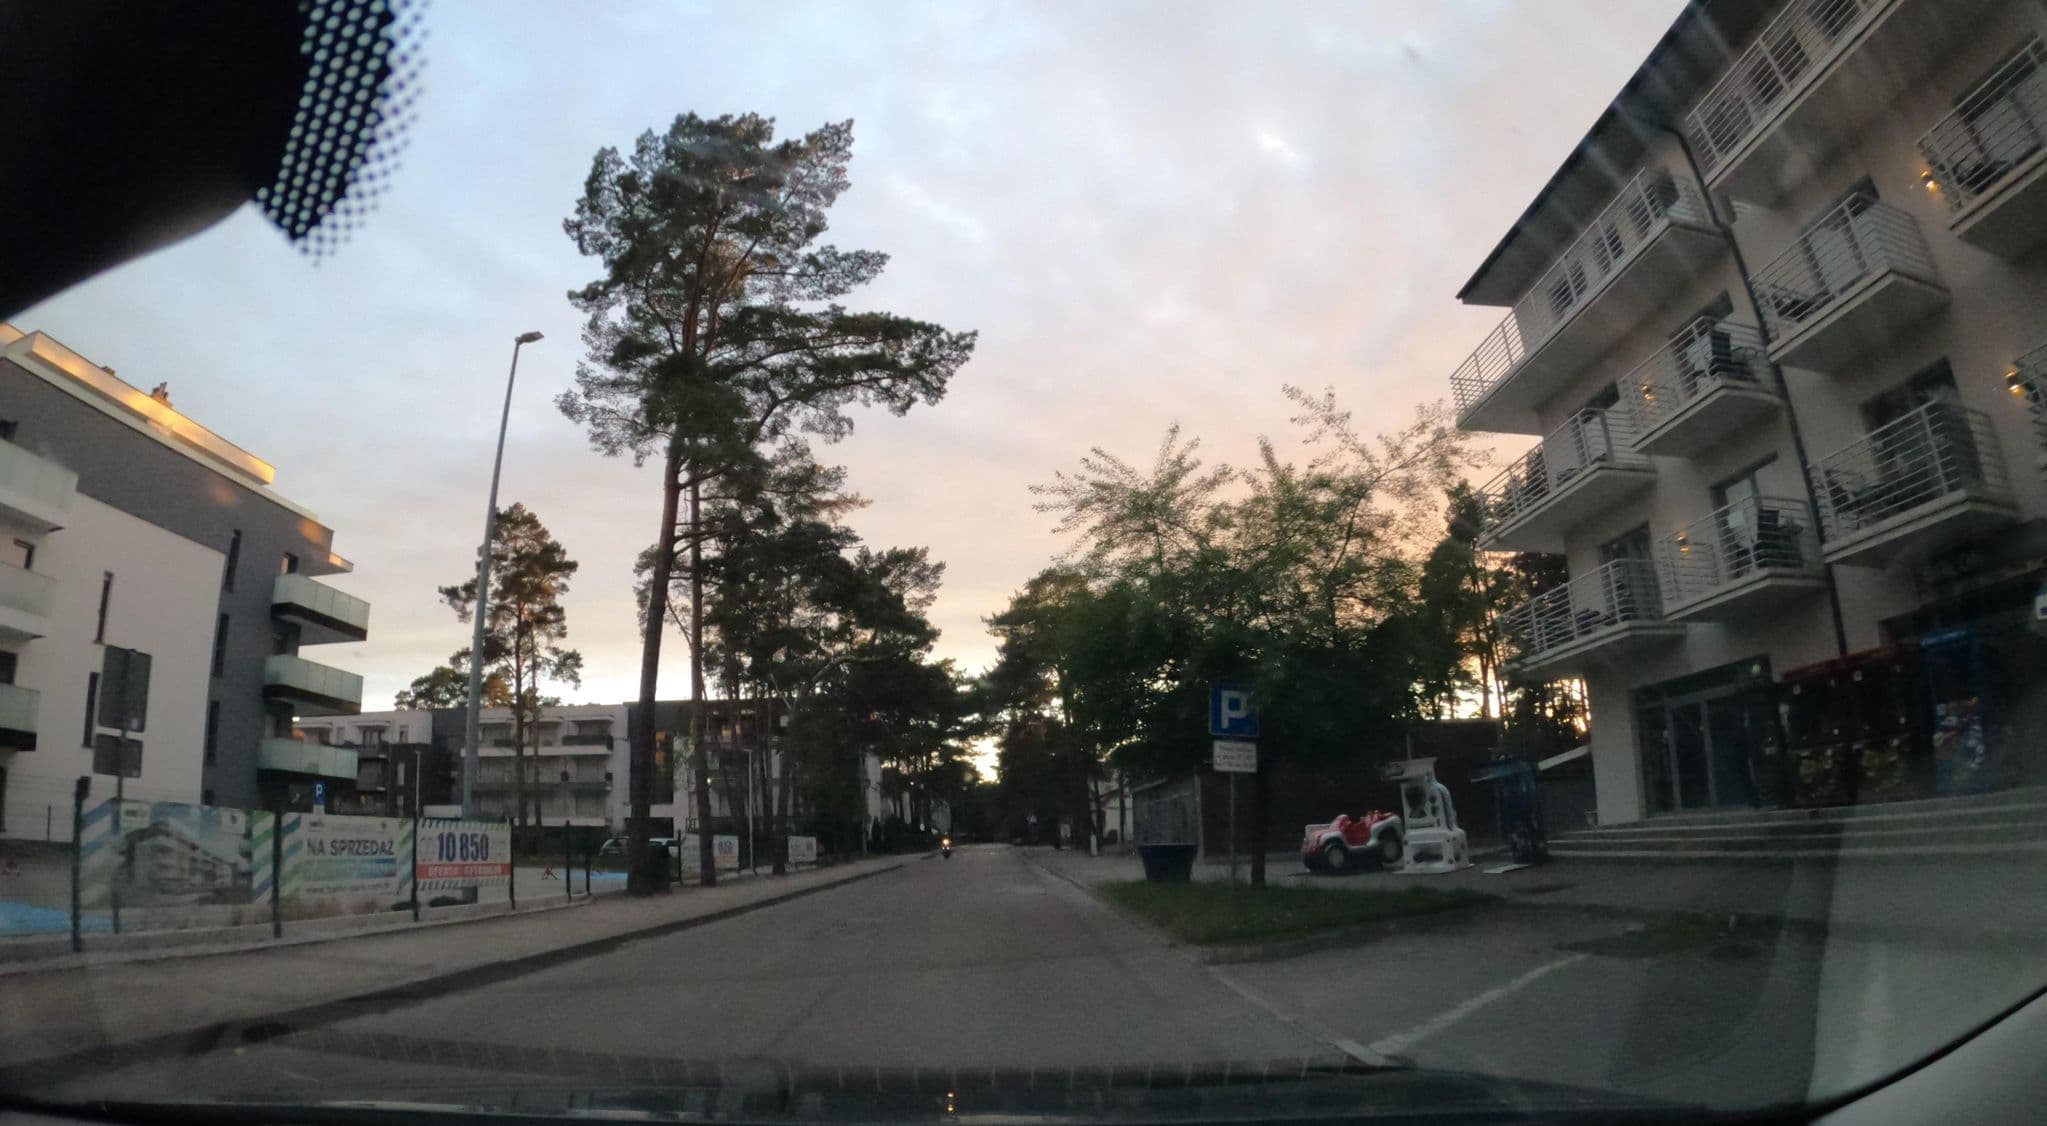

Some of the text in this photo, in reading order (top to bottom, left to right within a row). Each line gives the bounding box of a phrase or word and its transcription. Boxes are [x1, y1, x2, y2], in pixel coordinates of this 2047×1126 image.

[1221, 690, 1248, 729] P
[315, 783, 323, 797] P
[307, 838, 326, 856] NA
[438, 832, 456, 862] 10
[459, 832, 489, 862] 850
